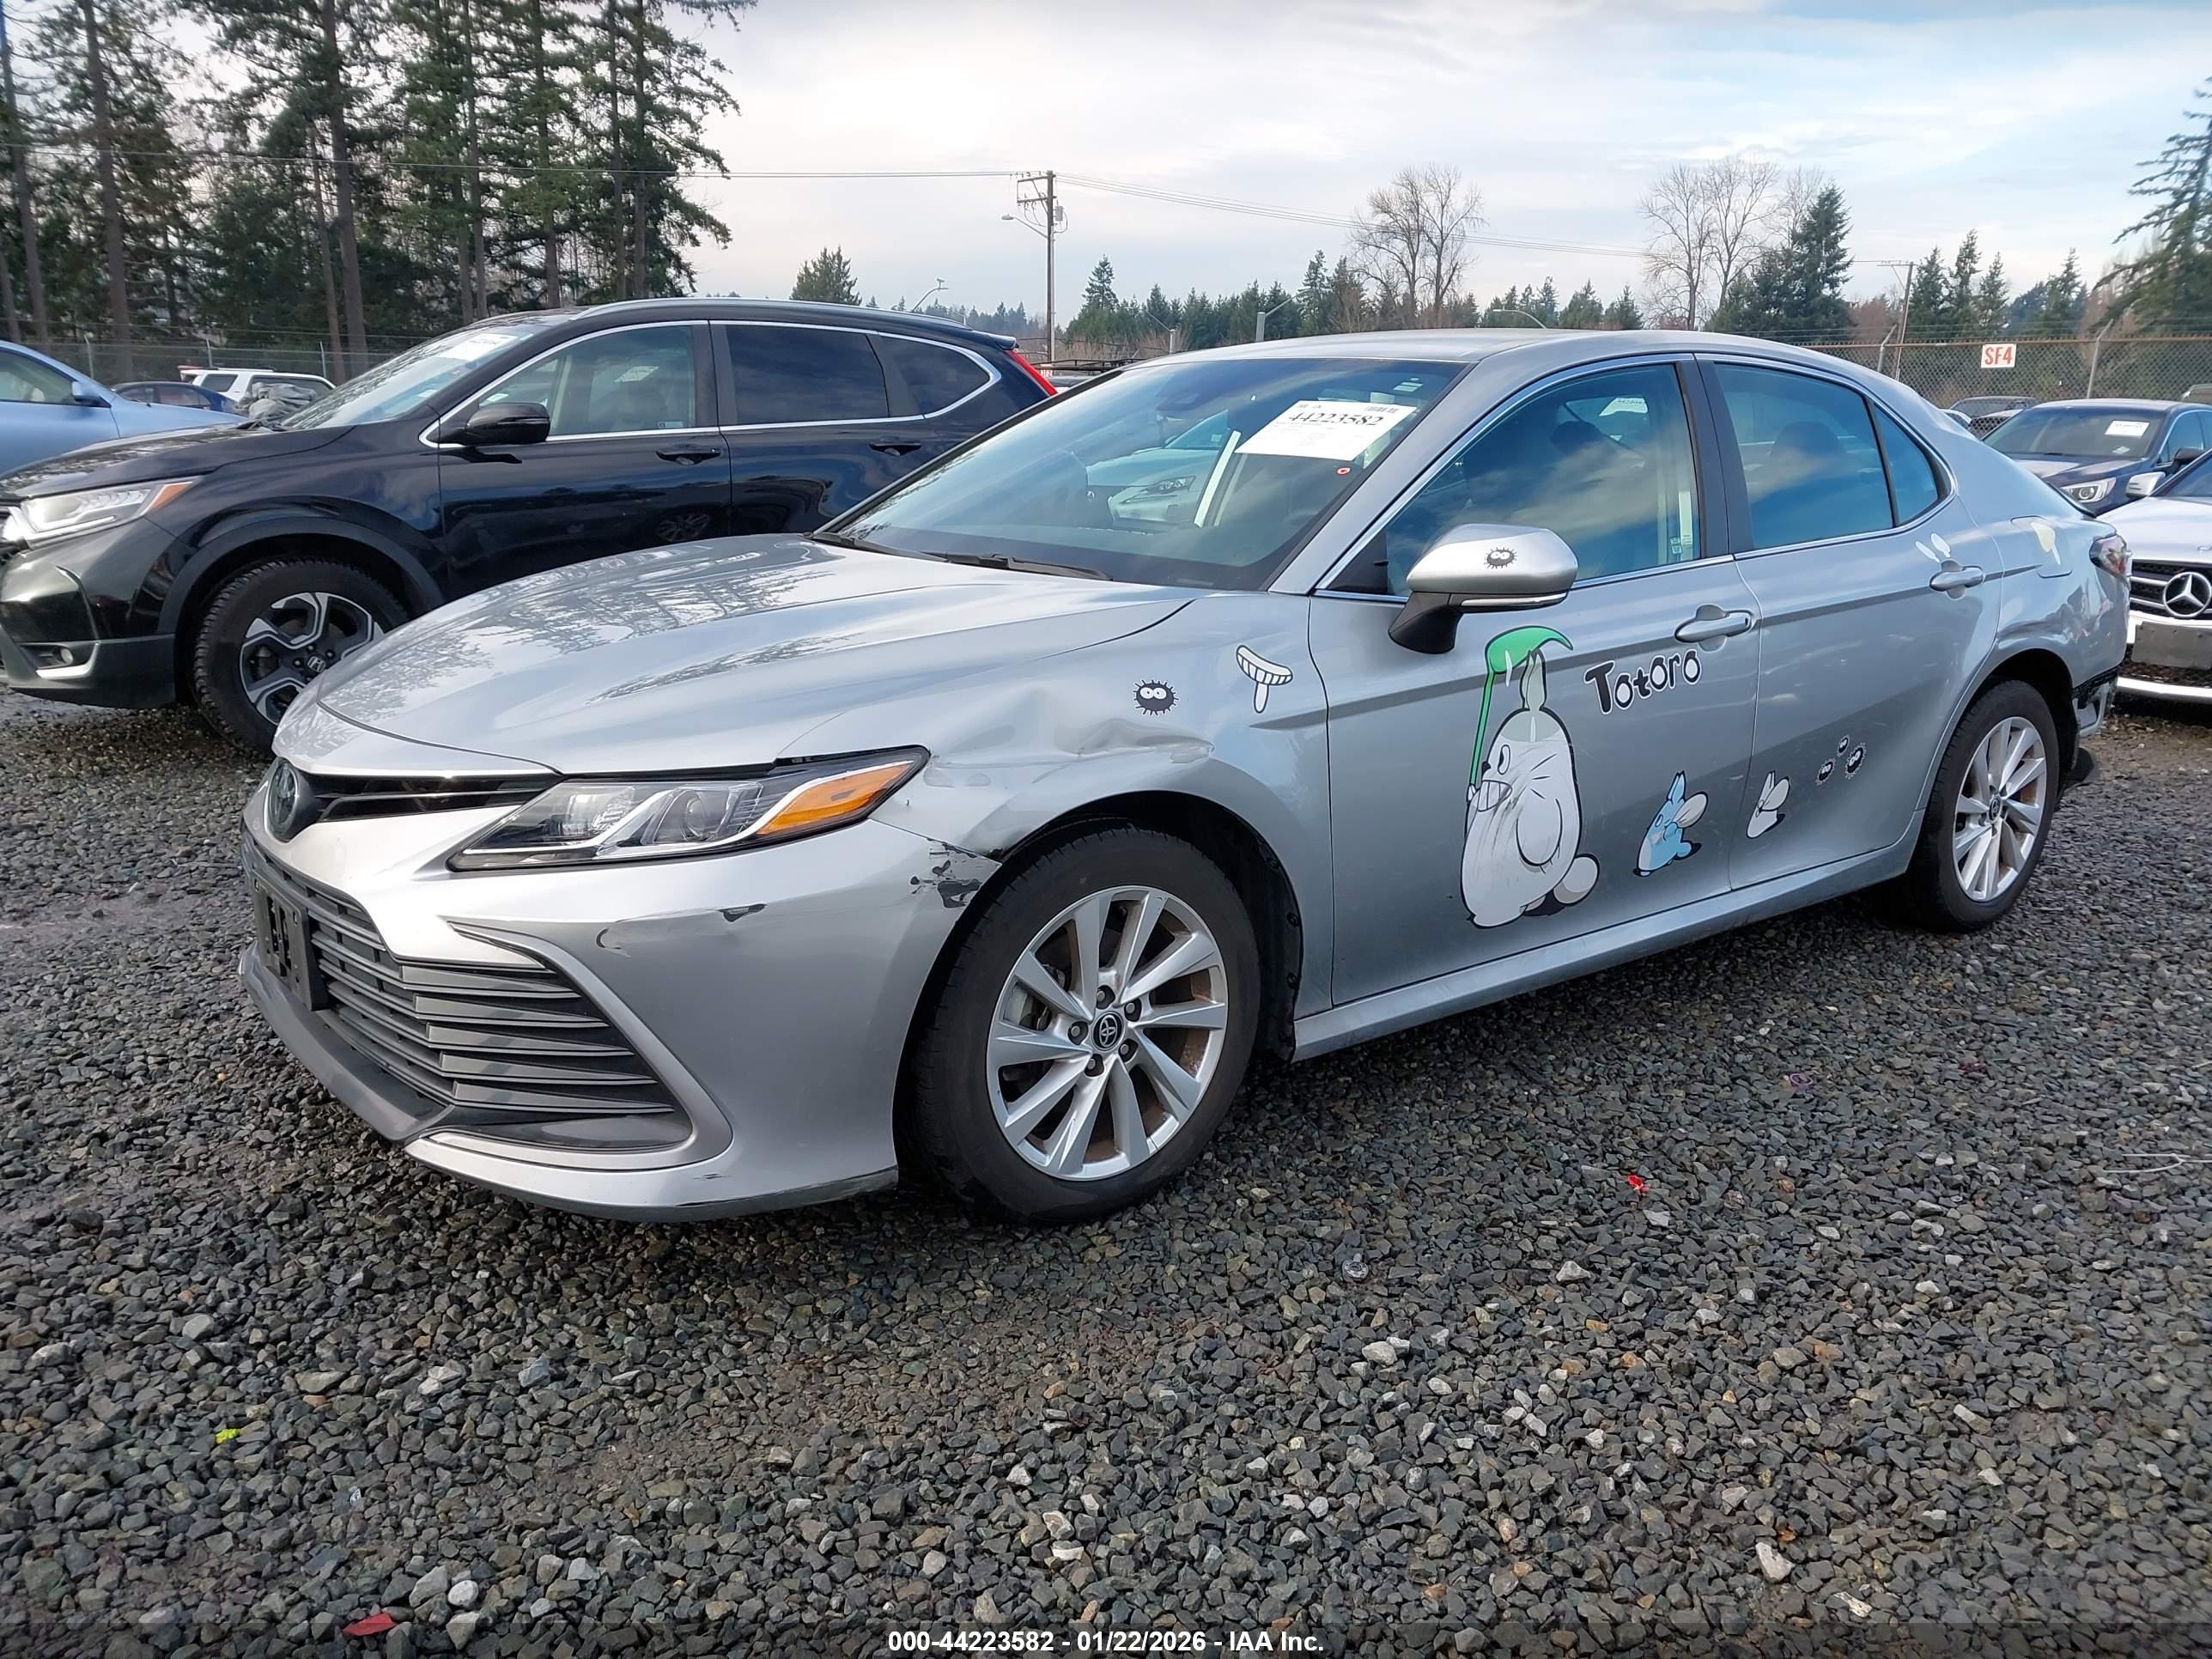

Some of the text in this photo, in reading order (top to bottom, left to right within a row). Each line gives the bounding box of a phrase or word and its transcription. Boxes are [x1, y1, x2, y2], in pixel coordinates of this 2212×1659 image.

[1984, 346, 2013, 365] SF4
[1289, 411, 1384, 426] 44223582
[1584, 649, 1701, 714] Totoro
